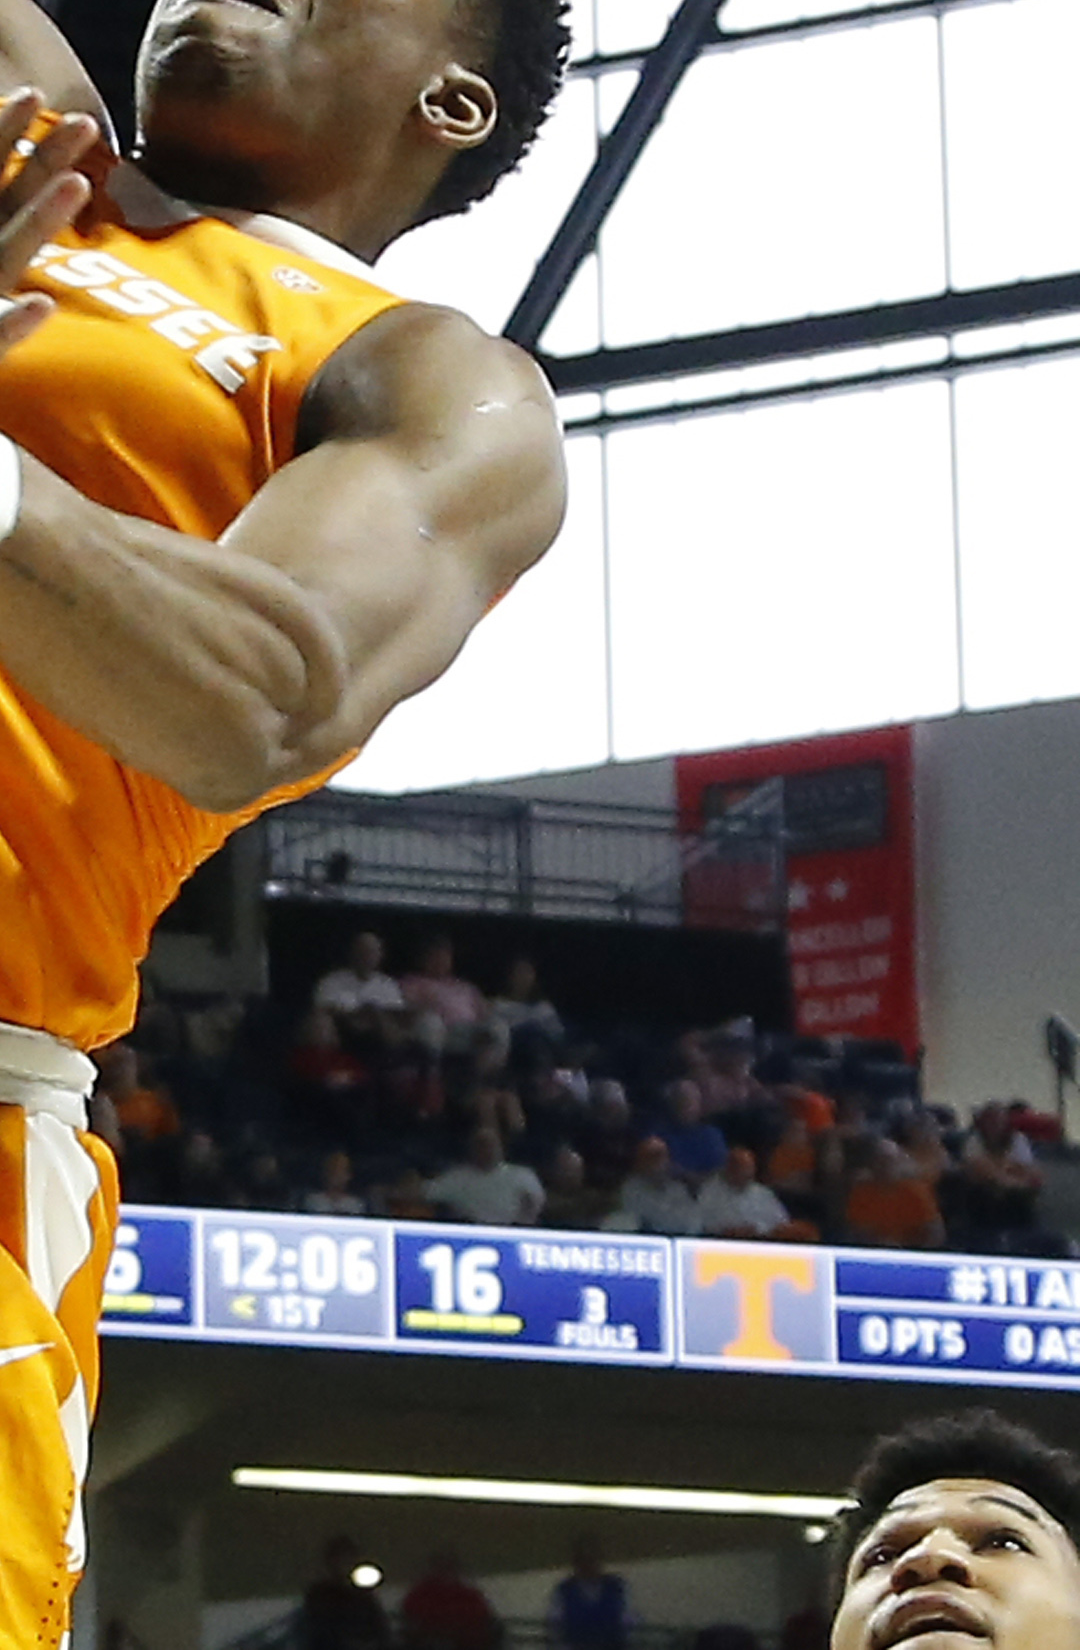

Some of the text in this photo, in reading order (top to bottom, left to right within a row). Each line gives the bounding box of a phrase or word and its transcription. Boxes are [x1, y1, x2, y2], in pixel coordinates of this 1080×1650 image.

[212, 1229, 377, 1294] 12:06
[520, 1242, 664, 1273] TENNESSEE
[422, 1244, 503, 1313] 16
[951, 1266, 1028, 1305] #11
[268, 1295, 324, 1328] 1ST
[581, 1286, 608, 1324] 3
[557, 1321, 638, 1350] FOULS
[891, 1317, 966, 1360] PTS
